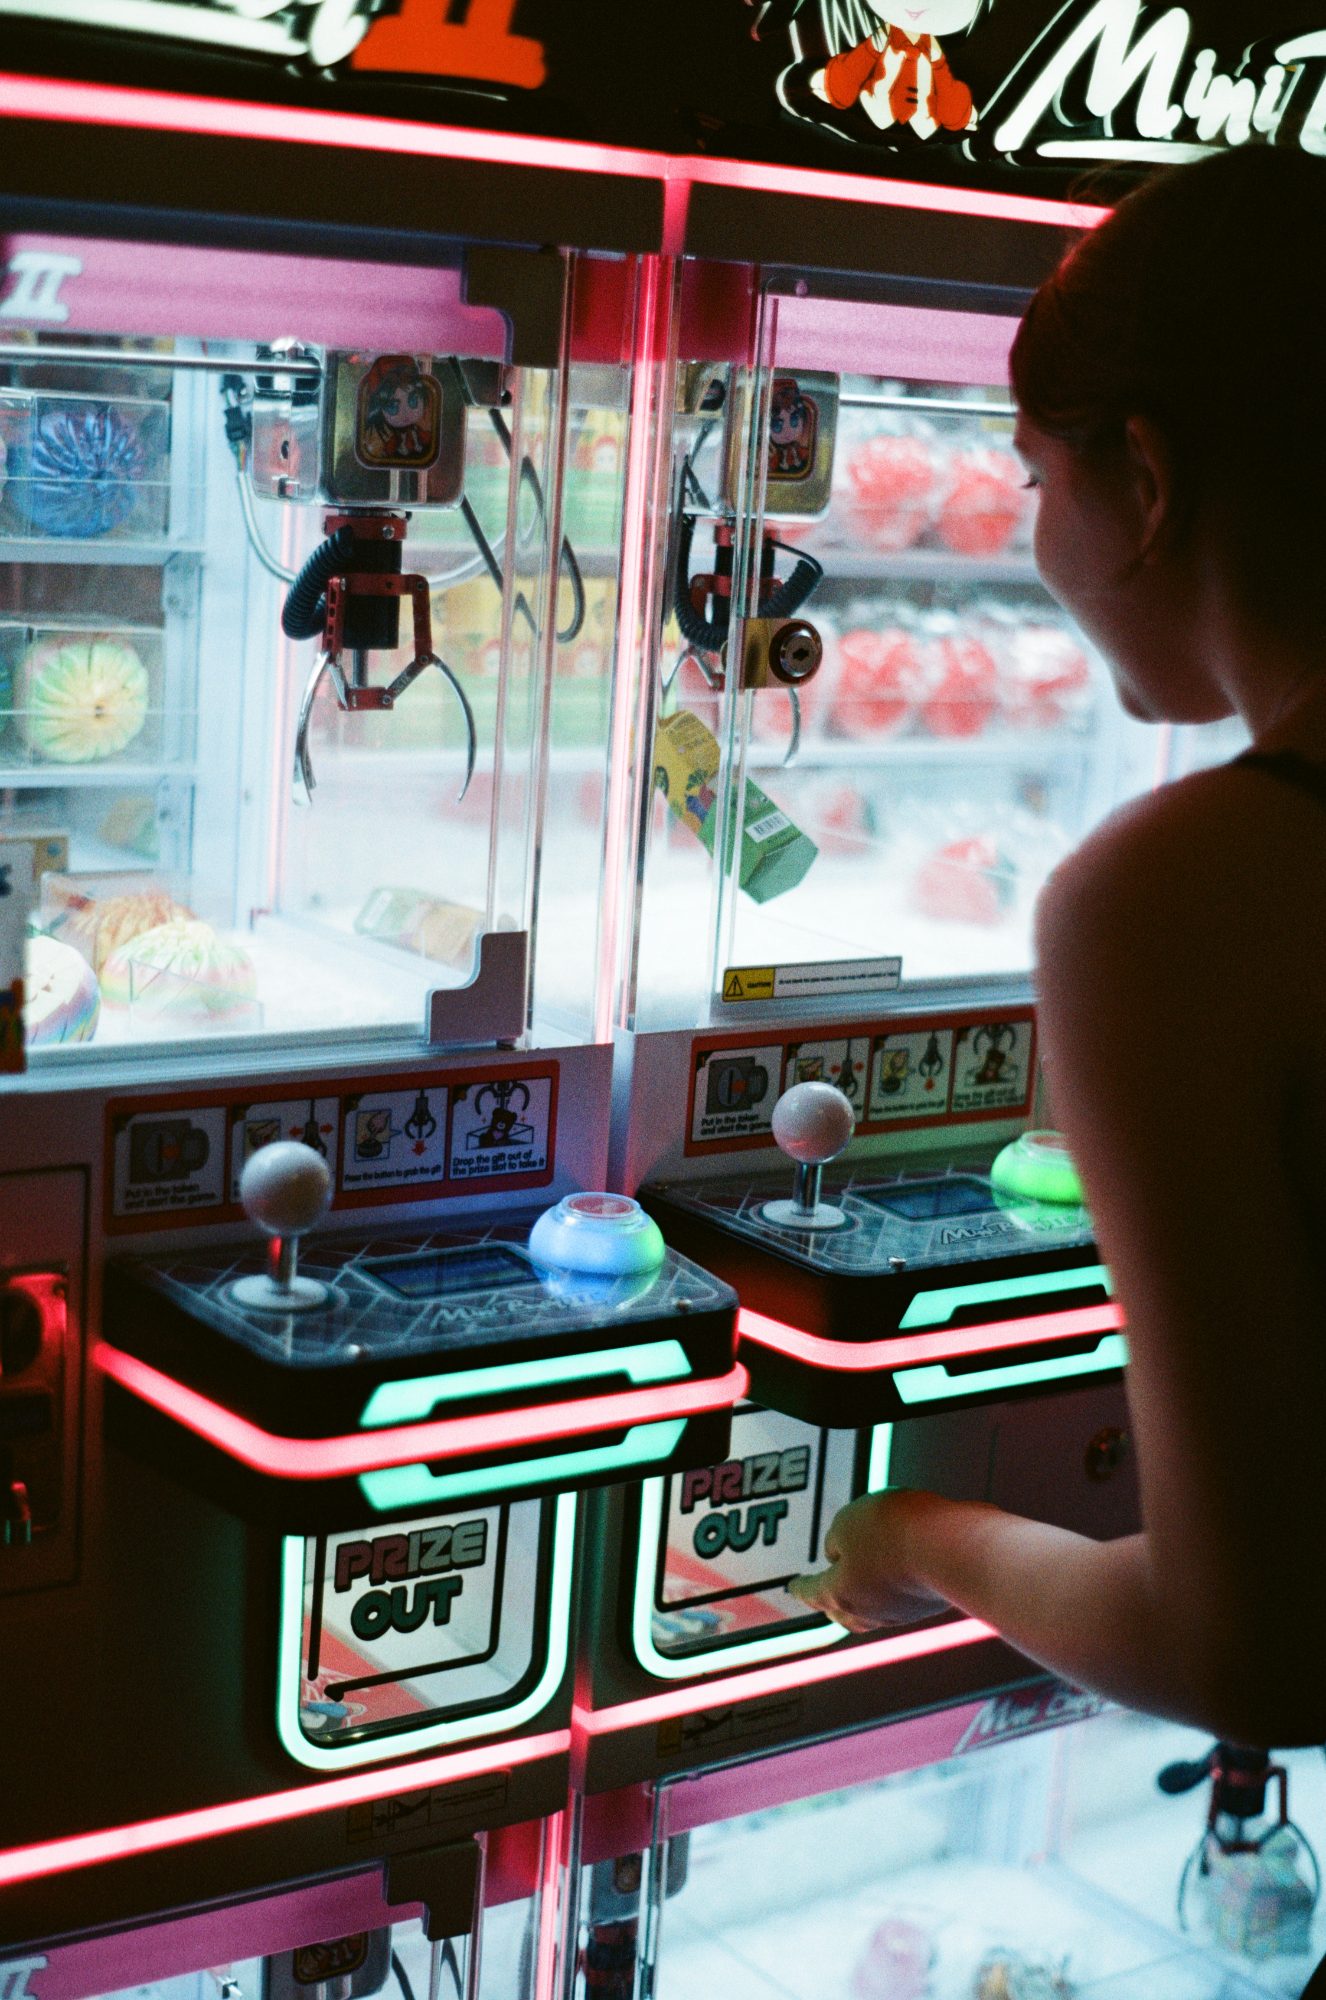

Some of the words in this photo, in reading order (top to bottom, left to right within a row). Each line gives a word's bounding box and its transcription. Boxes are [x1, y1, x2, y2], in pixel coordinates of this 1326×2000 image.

[453, 1157, 474, 1168] Drop
[476, 1154, 490, 1163] the
[491, 1151, 506, 1164] gift
[507, 1151, 521, 1160] out
[523, 1149, 533, 1159] of
[453, 1167, 467, 1175] the
[468, 1164, 490, 1176] prize
[508, 1161, 517, 1169] to
[519, 1159, 537, 1169] take
[680, 1445, 811, 1515] PRIZE
[334, 1518, 488, 1593] PRIZE
[693, 1499, 788, 1560] OUT
[351, 1574, 463, 1641] OUT
